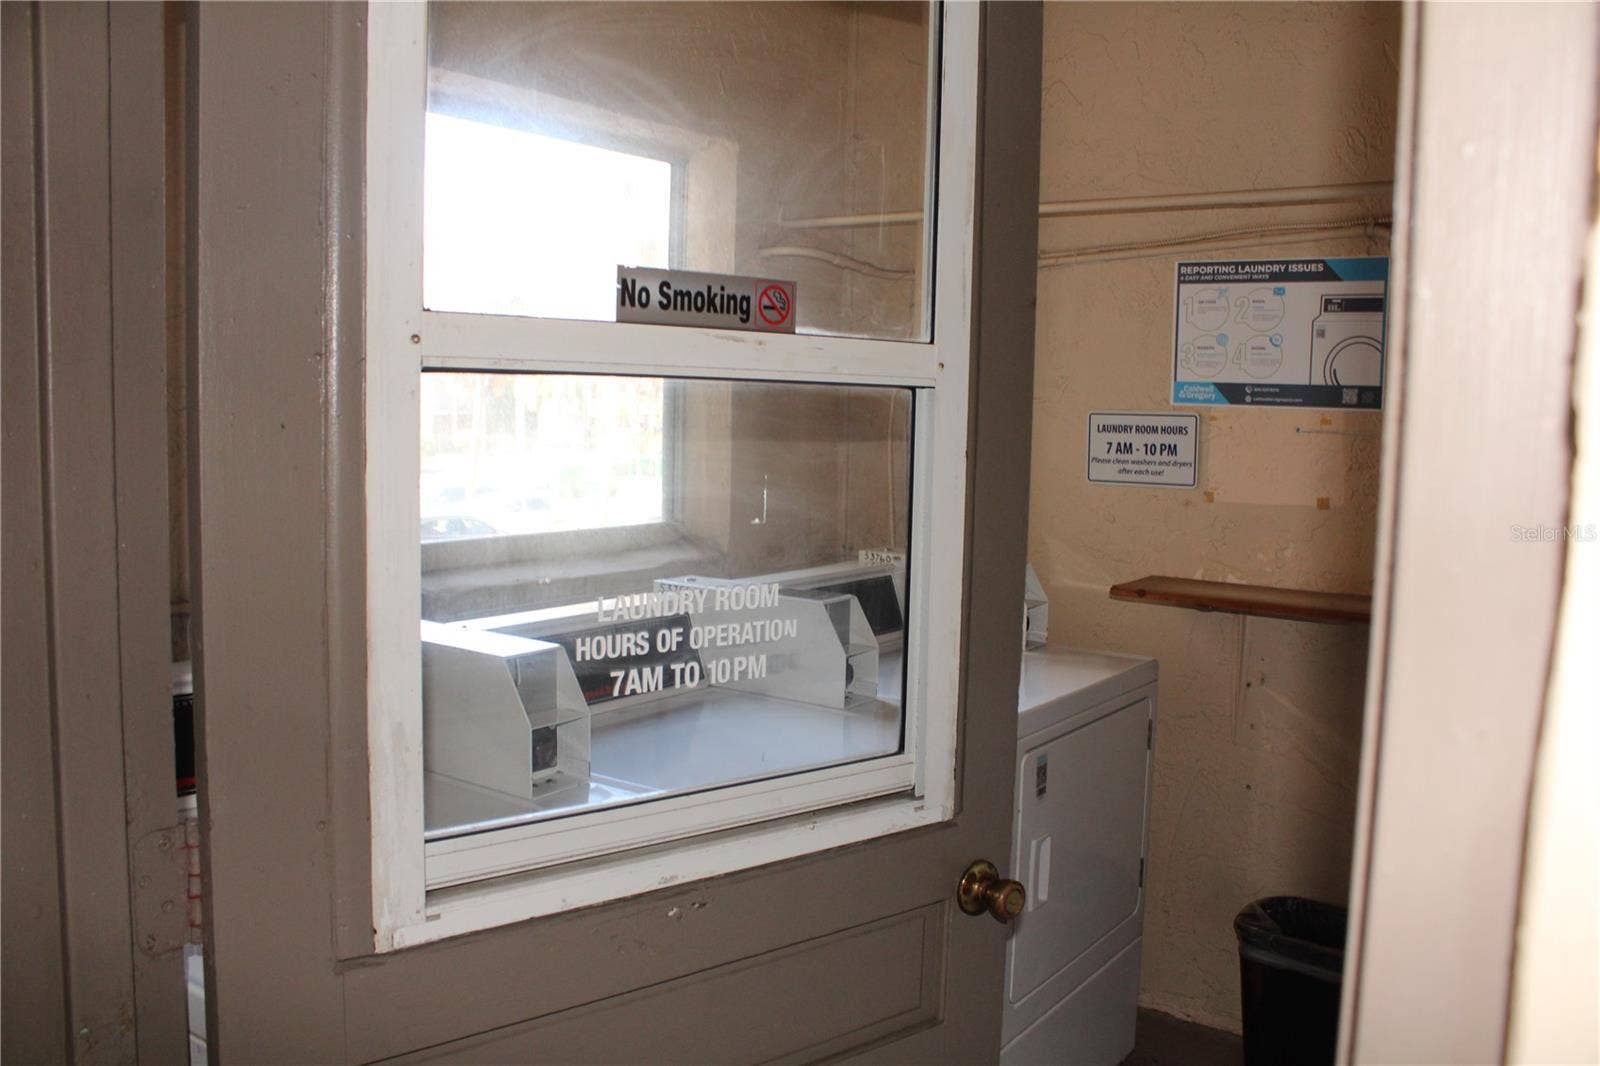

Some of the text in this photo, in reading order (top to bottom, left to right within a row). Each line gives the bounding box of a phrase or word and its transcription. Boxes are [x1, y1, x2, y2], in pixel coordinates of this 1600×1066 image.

[1180, 262, 1324, 275] REPORTING LAUNDRY ISSUES
[620, 278, 751, 324] No Smoking
[1183, 296, 1194, 324] 1
[1234, 295, 1250, 323] 2
[1181, 342, 1195, 368] 3
[1232, 342, 1247, 370] 4
[1097, 424, 1189, 436] LAUNDRY ROOM HOURS
[1091, 457, 1193, 469] Please clean washers and dryers
[1106, 442, 1113, 454] 7
[1115, 442, 1133, 455] AM
[1143, 443, 1157, 456] 10
[1159, 443, 1178, 457] PM
[598, 583, 780, 622] LAUNDRY ROOM
[575, 619, 798, 661] HOURS OF OPERATION
[609, 665, 663, 697] 7AM
[670, 661, 699, 689] TO
